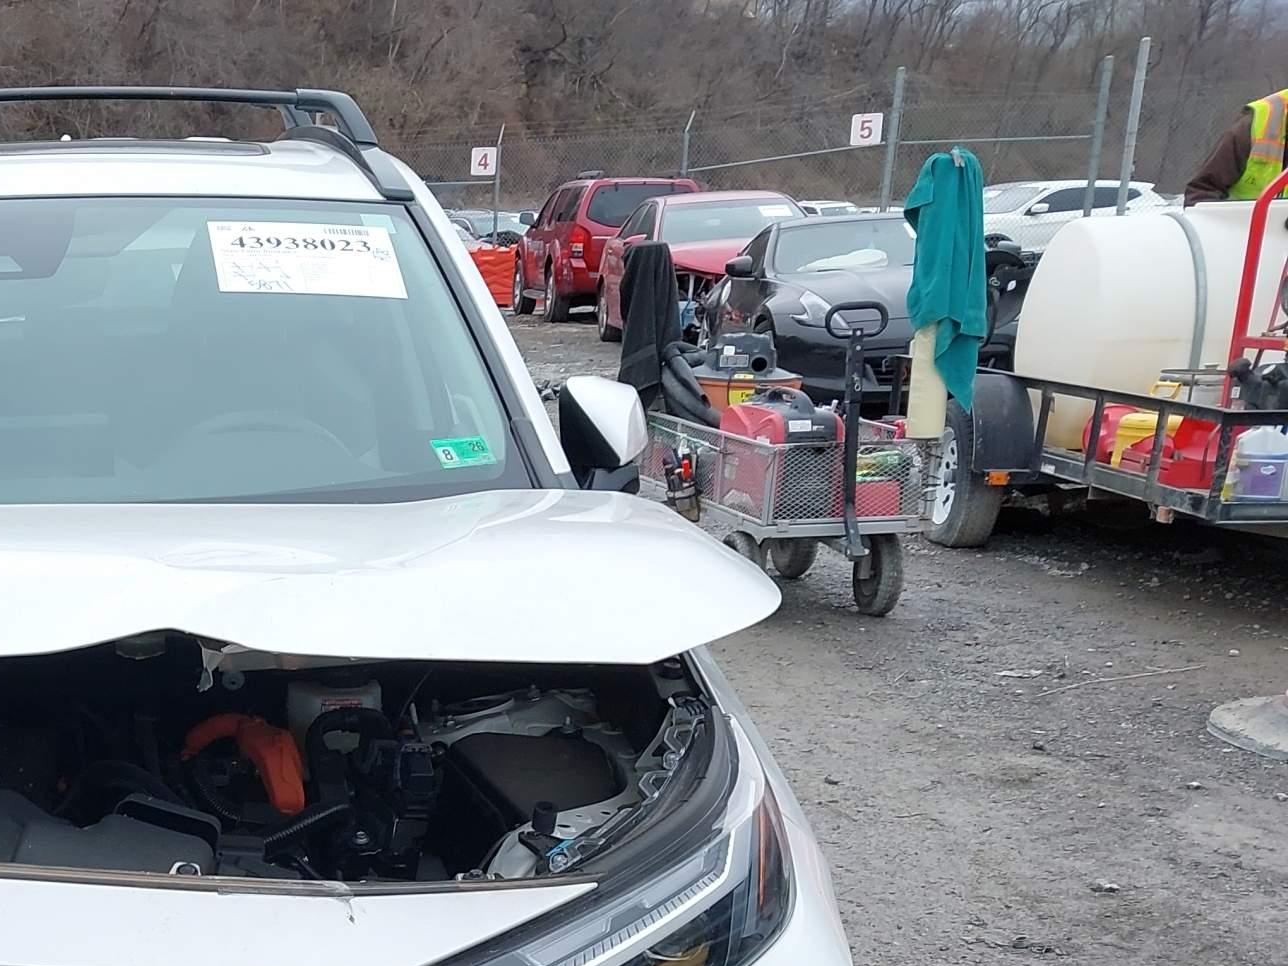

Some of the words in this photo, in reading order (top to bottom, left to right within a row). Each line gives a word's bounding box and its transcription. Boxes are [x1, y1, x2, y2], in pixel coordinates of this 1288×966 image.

[859, 119, 873, 140] 5
[477, 152, 490, 170] 4
[230, 235, 372, 253] 43938023
[442, 448, 454, 461] 8
